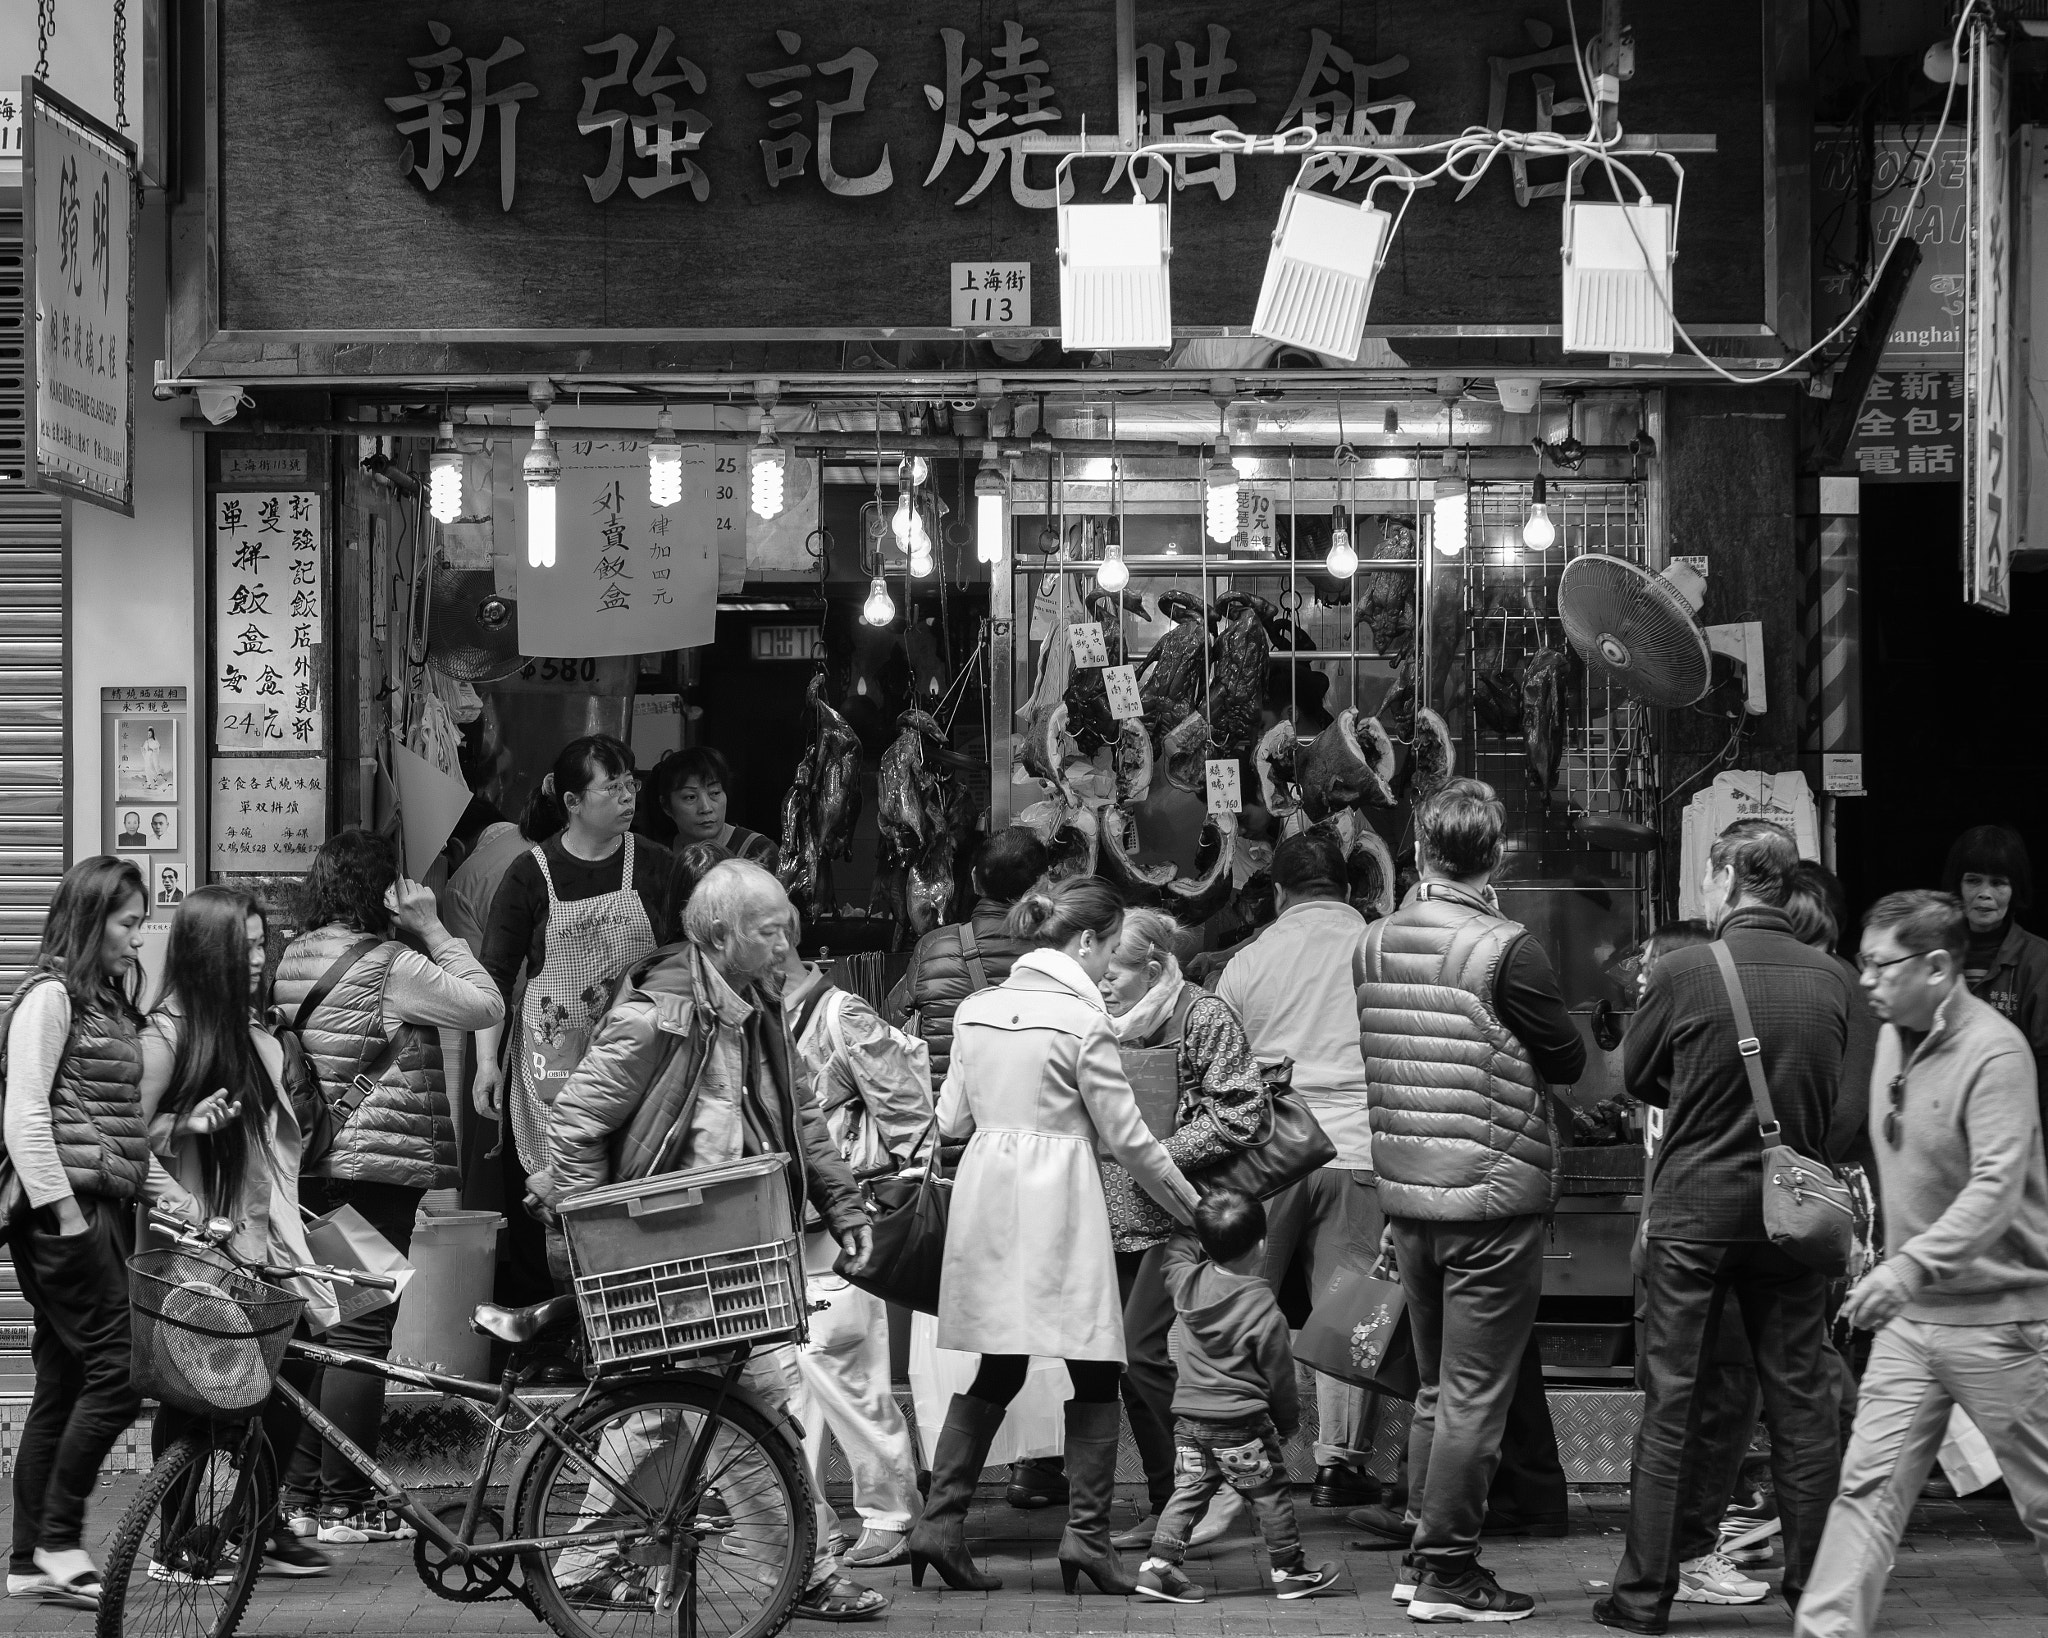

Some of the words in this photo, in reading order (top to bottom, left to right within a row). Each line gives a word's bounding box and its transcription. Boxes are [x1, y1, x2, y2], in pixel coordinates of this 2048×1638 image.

[960, 270, 1025, 293] 上海街
[969, 298, 1014, 322] 113
[91, 397, 104, 422] GLASS
[1857, 406, 1965, 438] 全包
[230, 458, 301, 473] 上海街113號
